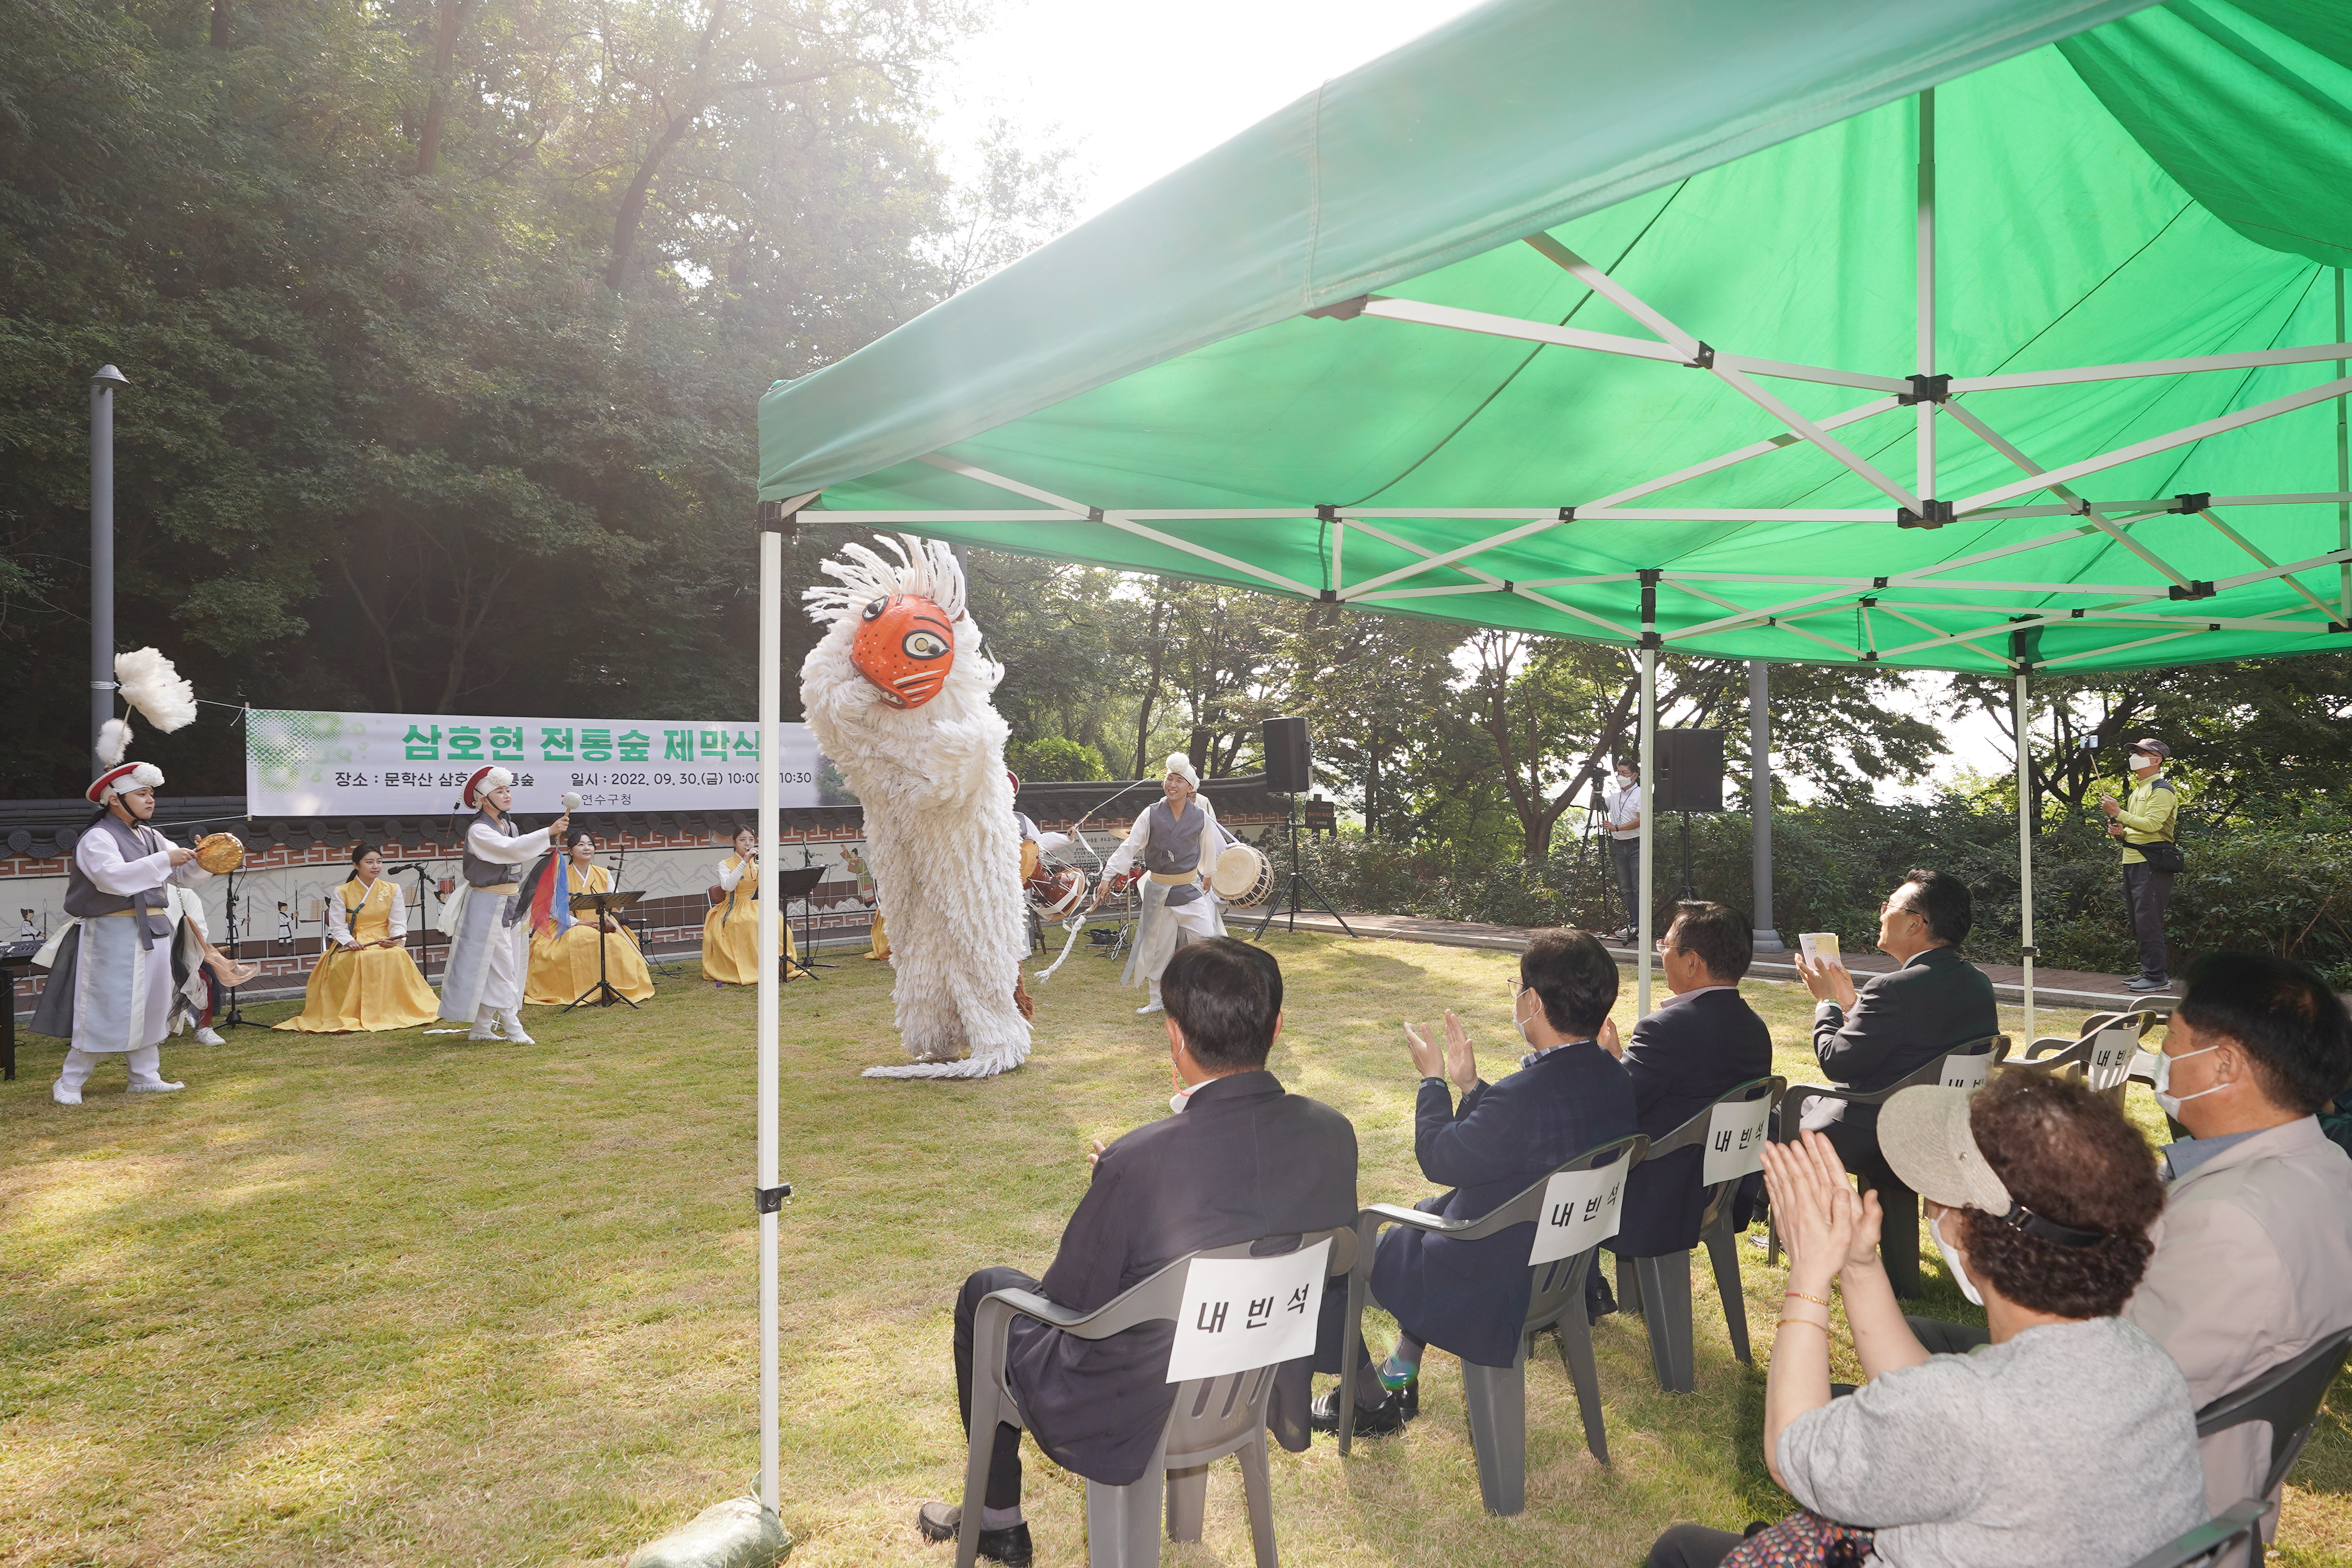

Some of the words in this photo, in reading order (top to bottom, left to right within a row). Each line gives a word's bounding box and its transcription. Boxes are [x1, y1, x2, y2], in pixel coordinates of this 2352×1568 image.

[402, 724, 524, 761] 삼호현
[540, 727, 650, 762] 전통숲
[663, 730, 759, 762] 제막식
[335, 772, 368, 787] 장소
[385, 772, 433, 787] 문학산
[439, 771, 472, 787] 삼호
[509, 773, 535, 787] 통숲
[571, 773, 598, 787] 일시
[611, 773, 650, 786] 2022.
[654, 773, 675, 786] 09.
[779, 772, 812, 783] 10:30
[581, 793, 632, 805] 연수구청
